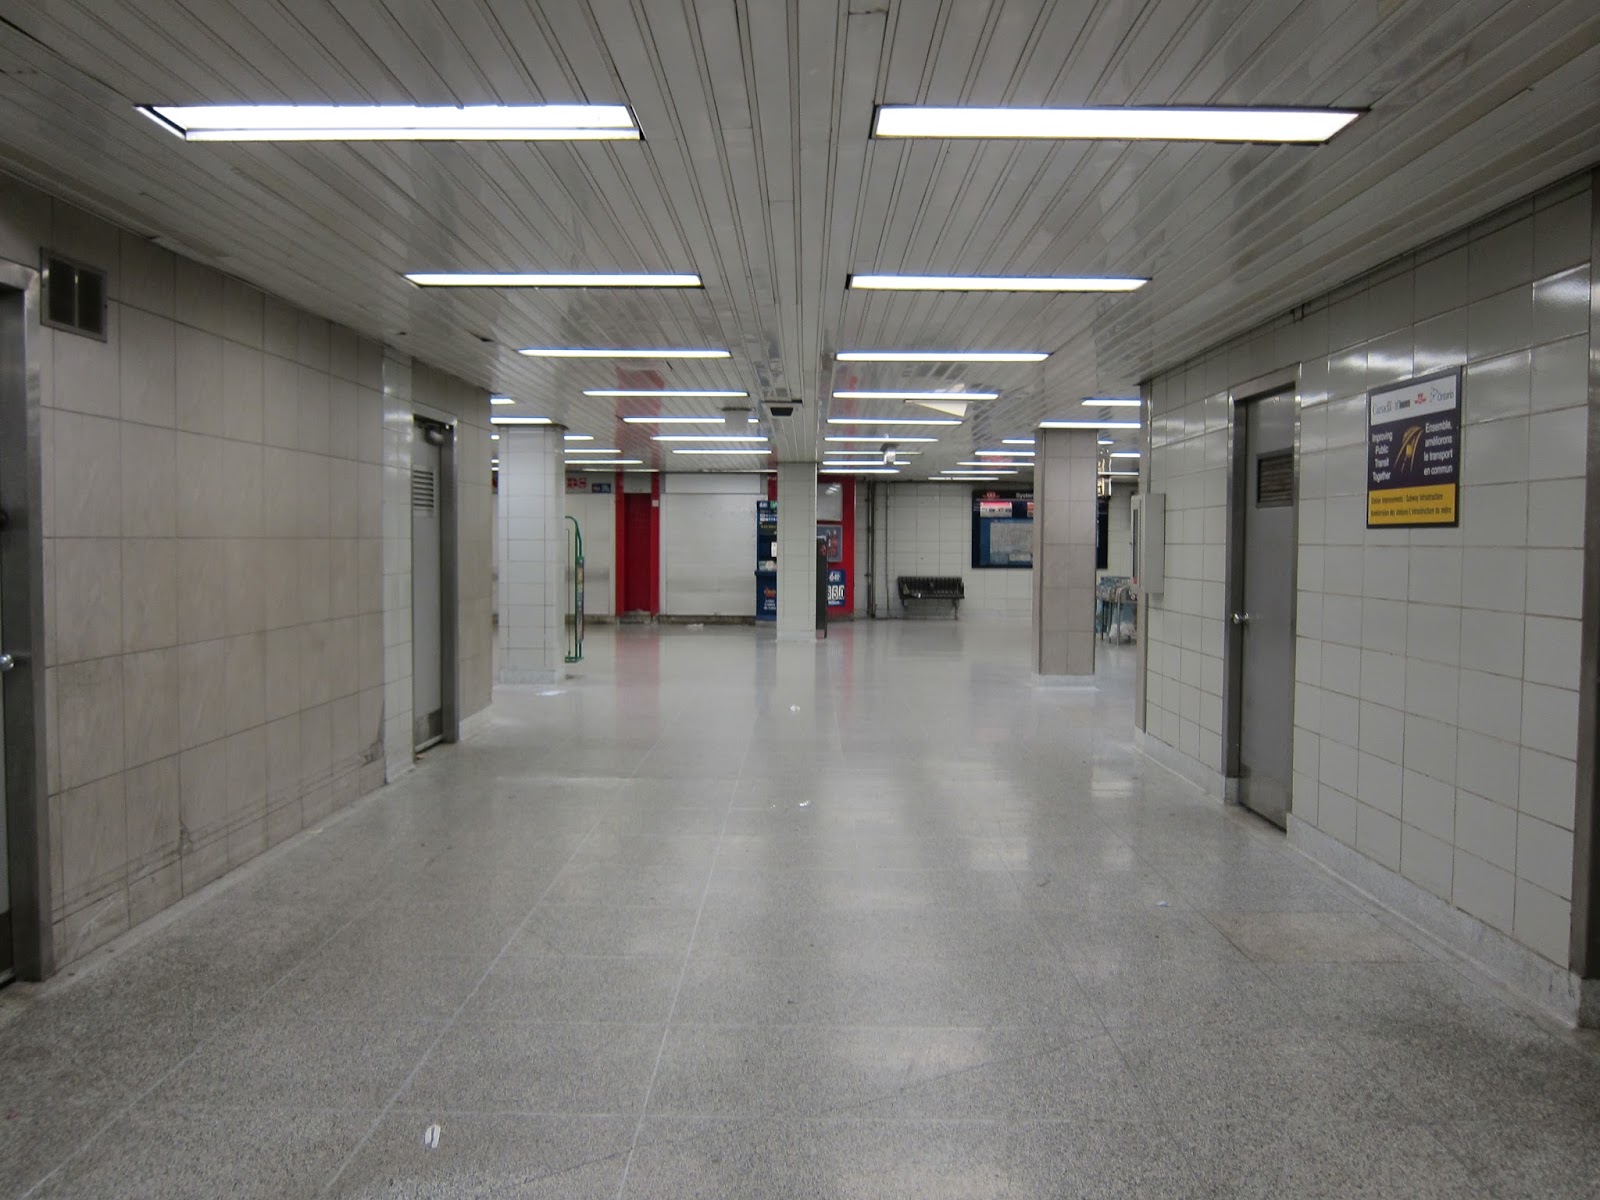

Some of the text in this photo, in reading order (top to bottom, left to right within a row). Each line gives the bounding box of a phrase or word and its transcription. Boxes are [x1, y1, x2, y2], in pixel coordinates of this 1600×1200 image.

[1372, 431, 1393, 443] Improving
[1375, 444, 1389, 455] Public
[1424, 449, 1453, 461] le transport
[1375, 457, 1389, 468] Transit
[1424, 465, 1453, 476] en commun
[1373, 470, 1391, 483] Together
